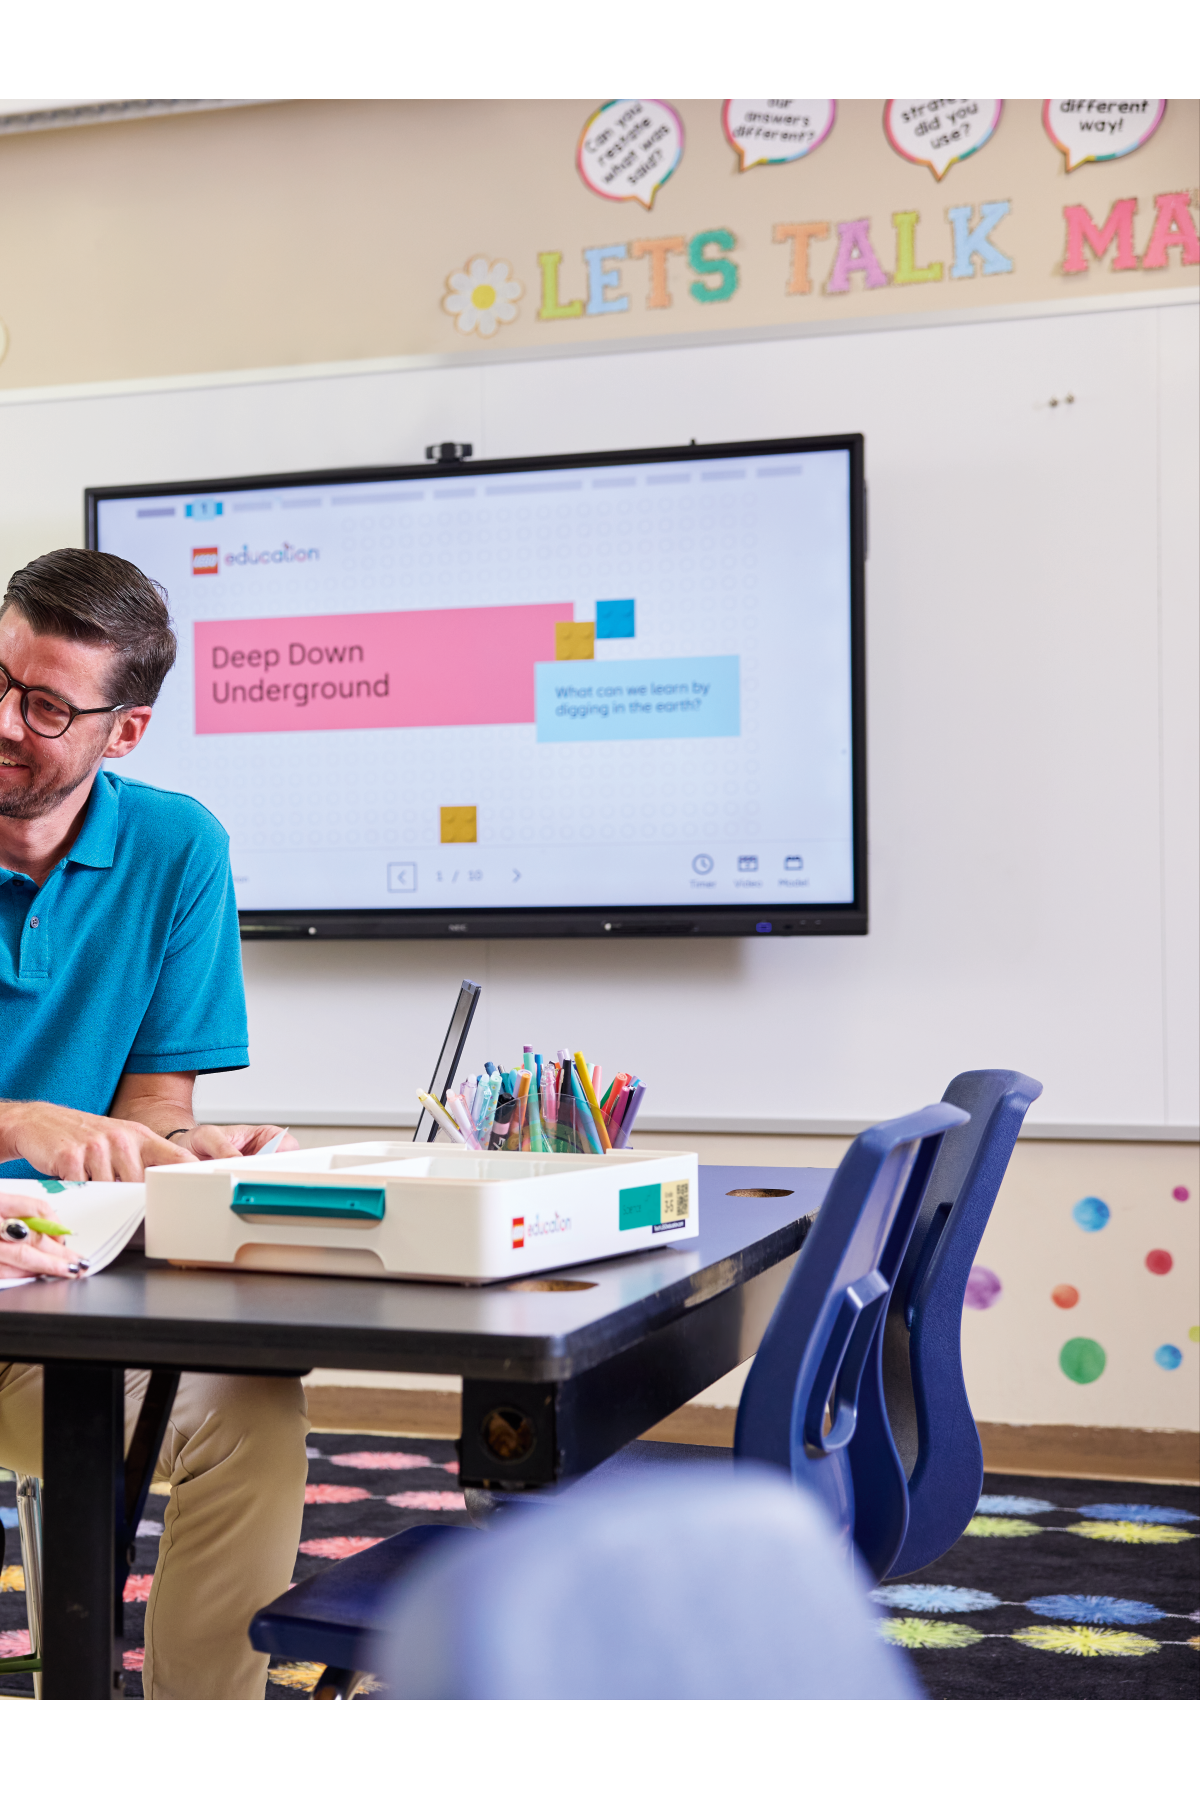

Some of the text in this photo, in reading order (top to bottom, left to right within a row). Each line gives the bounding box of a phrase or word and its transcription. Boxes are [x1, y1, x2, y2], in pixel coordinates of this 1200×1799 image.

[745, 112, 810, 127] answers
[914, 103, 978, 137] did you
[1060, 99, 1148, 114] different
[584, 102, 643, 153] Can you
[734, 127, 814, 142] different?
[930, 122, 970, 150] use?
[1080, 117, 1124, 135] way!
[598, 118, 651, 166] restate
[604, 124, 670, 184] what was
[628, 148, 663, 186] said?
[537, 191, 1200, 321] LETS TALK MA
[225, 541, 320, 567] education
[212, 642, 364, 672] Deep Down
[212, 673, 390, 706] Underground
[555, 680, 711, 699] What can we learn by
[555, 698, 702, 719] digging in the earth?
[690, 879, 717, 889] Timer
[528, 1210, 572, 1238] education
